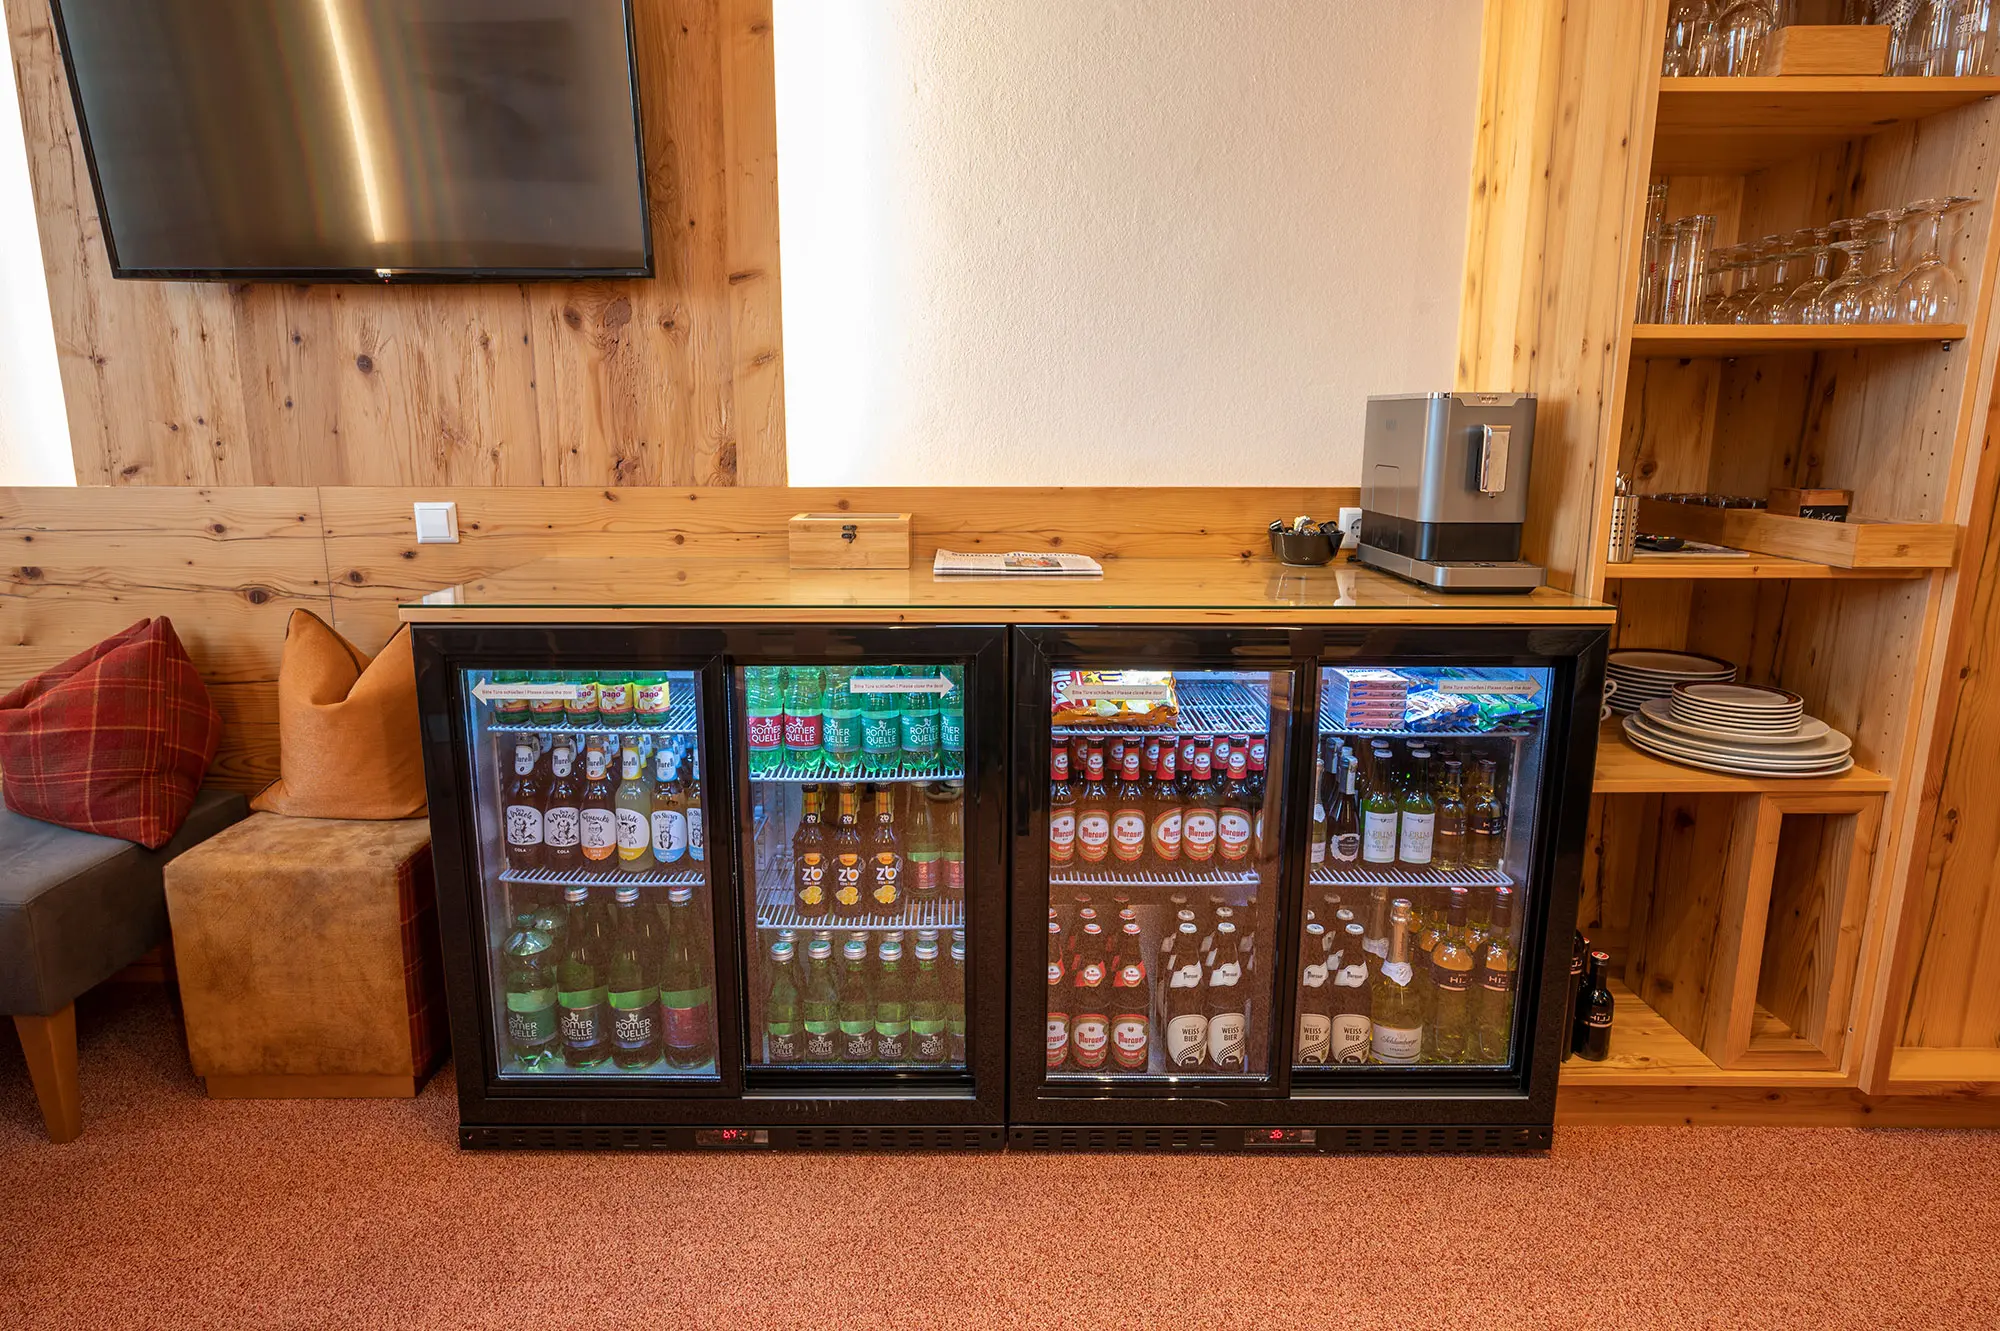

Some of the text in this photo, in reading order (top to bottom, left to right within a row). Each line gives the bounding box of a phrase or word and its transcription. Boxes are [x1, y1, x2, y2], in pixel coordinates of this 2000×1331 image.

[616, 1026, 651, 1039] QUELLE
[1182, 1027, 1200, 1035] WEISS
[1221, 1026, 1240, 1034] WEISS
[1303, 1027, 1322, 1035] WEISS
[1343, 1027, 1362, 1035] WEISS
[1305, 1034, 1320, 1042] BIER
[1345, 1034, 1360, 1042] BIER
